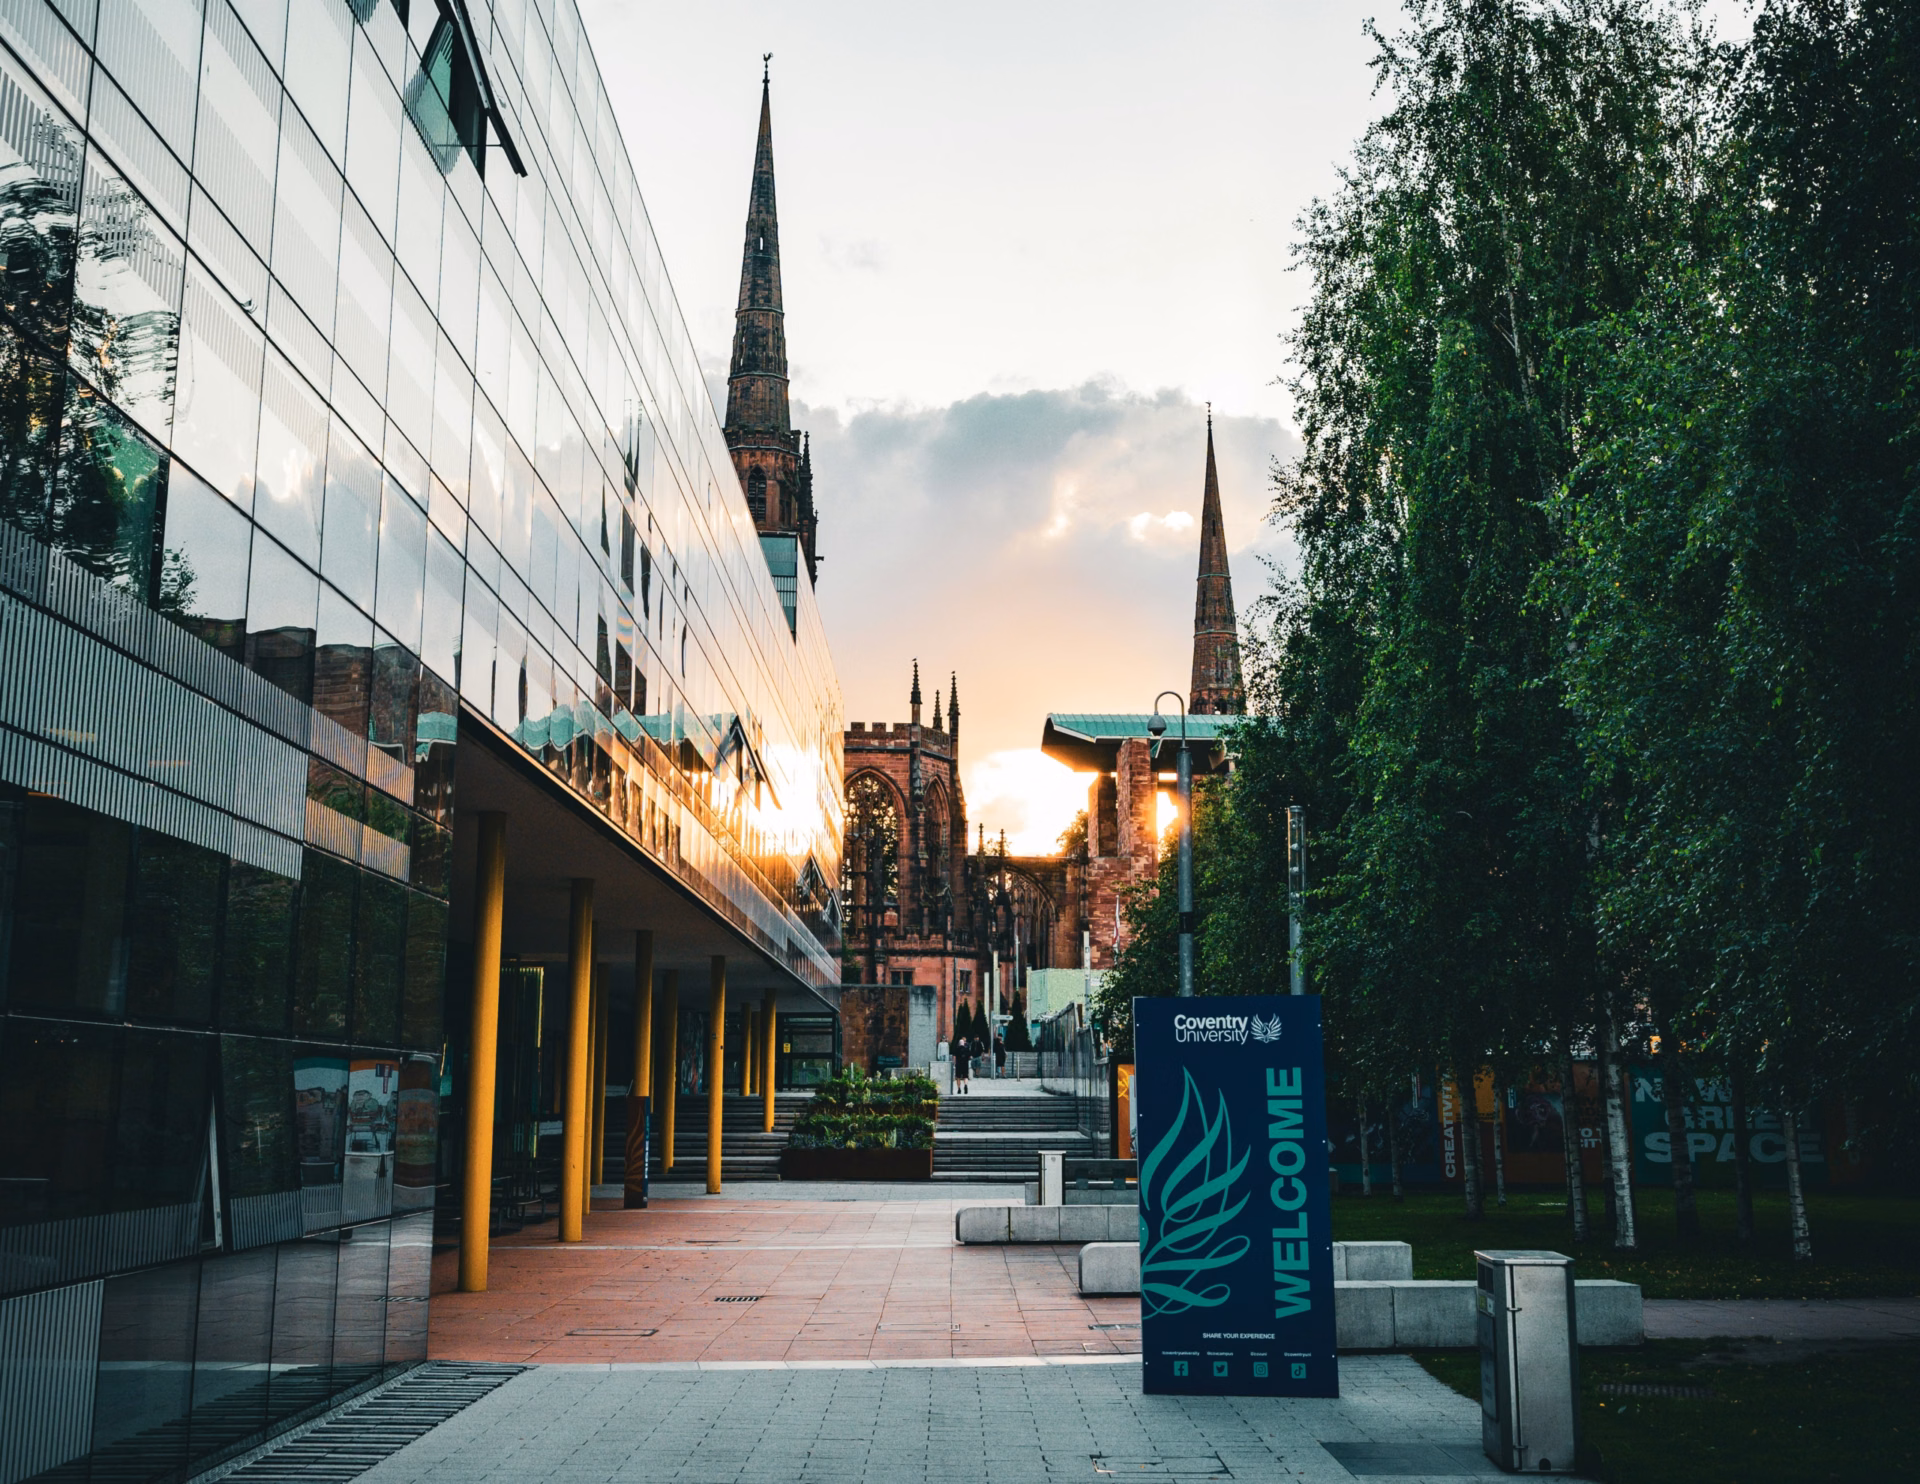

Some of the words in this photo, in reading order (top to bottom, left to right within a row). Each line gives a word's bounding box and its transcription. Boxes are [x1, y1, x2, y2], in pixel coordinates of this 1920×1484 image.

[1174, 1014, 1249, 1033] Coventry
[1175, 1028, 1249, 1045] University
[1634, 1075, 1733, 1103] NW
[1643, 1131, 1825, 1164] SPACE
[1266, 1066, 1312, 1319] WELCOME
